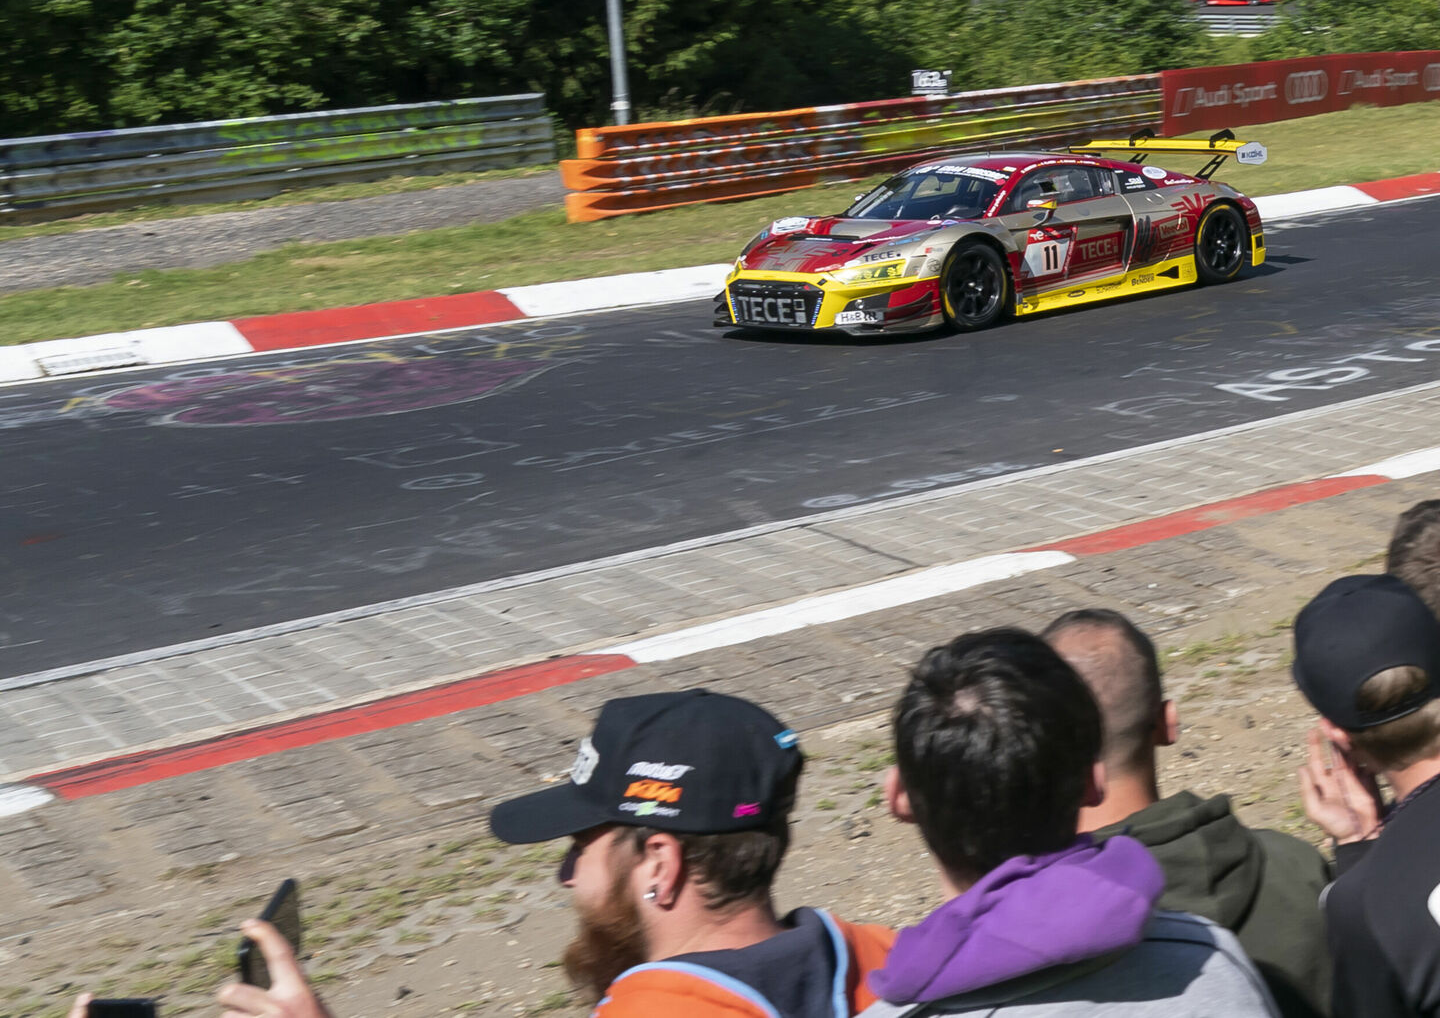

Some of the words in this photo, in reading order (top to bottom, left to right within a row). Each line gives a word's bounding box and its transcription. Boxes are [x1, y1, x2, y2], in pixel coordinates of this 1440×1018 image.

[1353, 69, 1383, 88] Audi
[1384, 68, 1419, 90] Sport
[1194, 85, 1231, 107] Audi
[1233, 82, 1278, 108] Sport
[863, 250, 895, 263] TECE
[1043, 244, 1059, 271] 11
[1080, 239, 1112, 261] TECE
[737, 295, 792, 324] TECE
